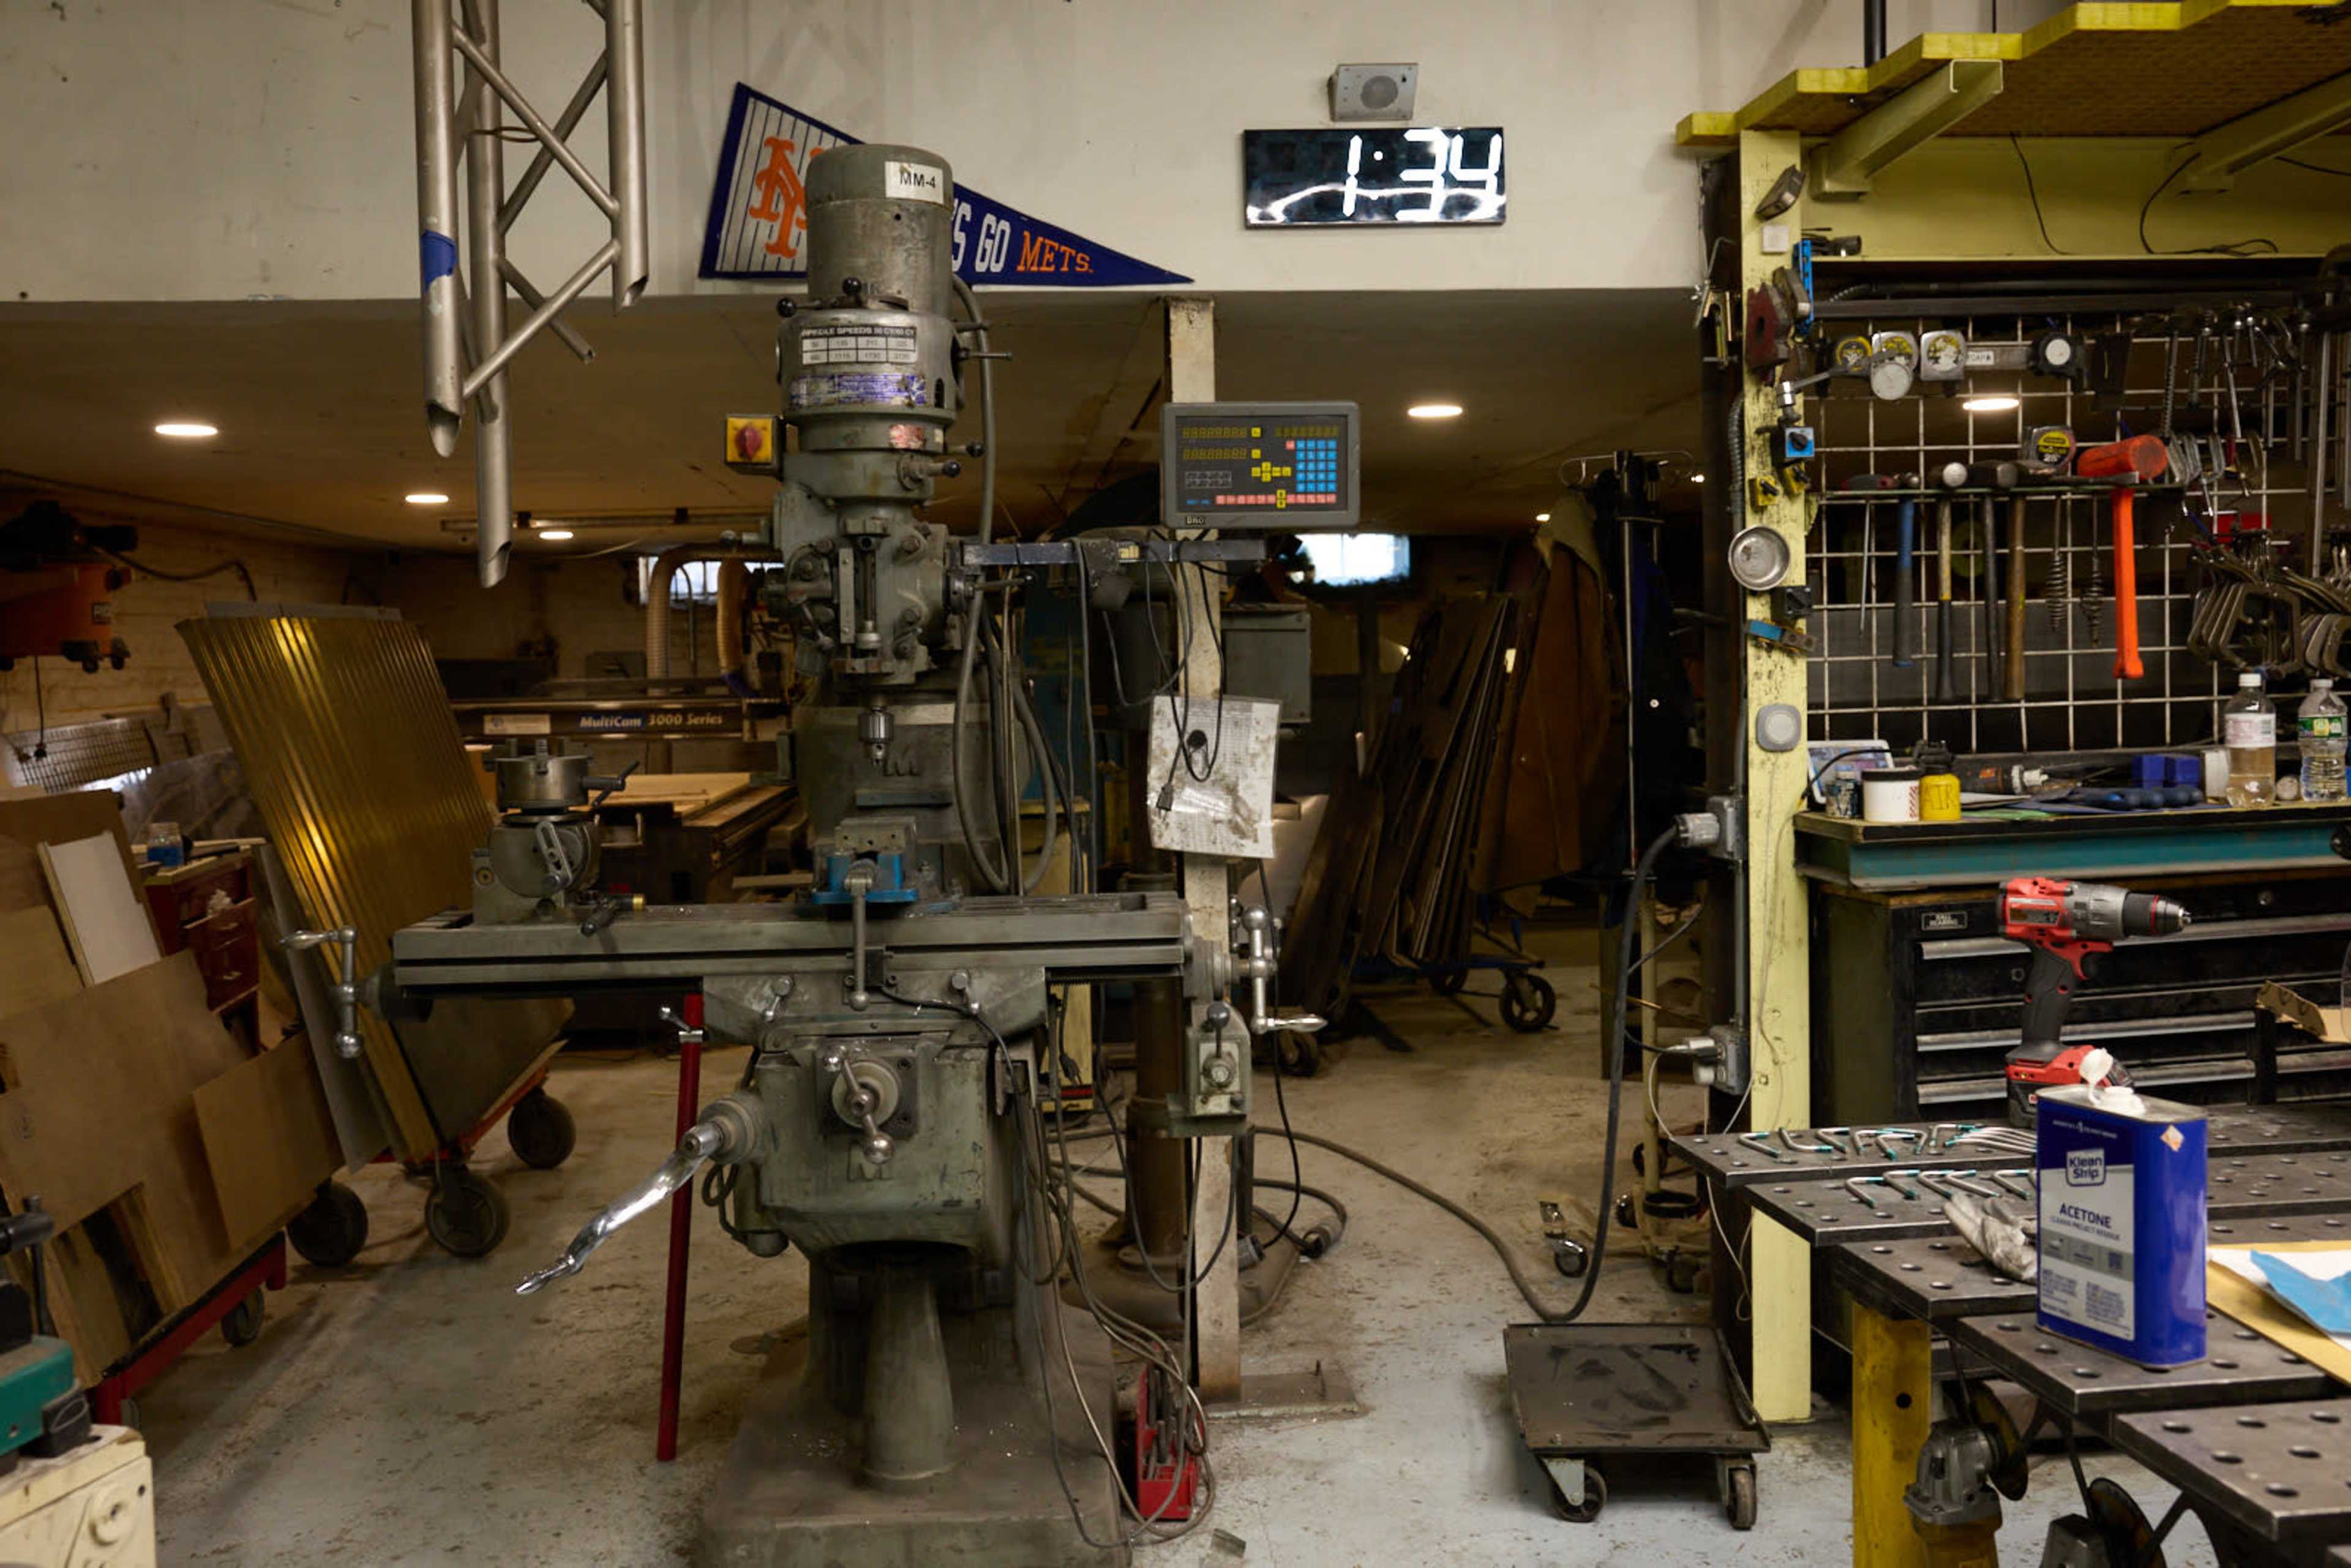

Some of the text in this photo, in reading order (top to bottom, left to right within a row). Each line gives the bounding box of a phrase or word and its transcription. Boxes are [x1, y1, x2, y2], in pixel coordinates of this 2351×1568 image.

[900, 172, 936, 189] MM-4
[975, 214, 1011, 272] GO
[1016, 231, 1091, 272] METS
[579, 713, 723, 727] MultiCam 3000 Series
[1922, 784, 1956, 810] AIR
[2069, 1156, 2102, 1167] Klean
[2073, 1167, 2099, 1180] Strip
[2059, 1202, 2112, 1229] ACETONE
